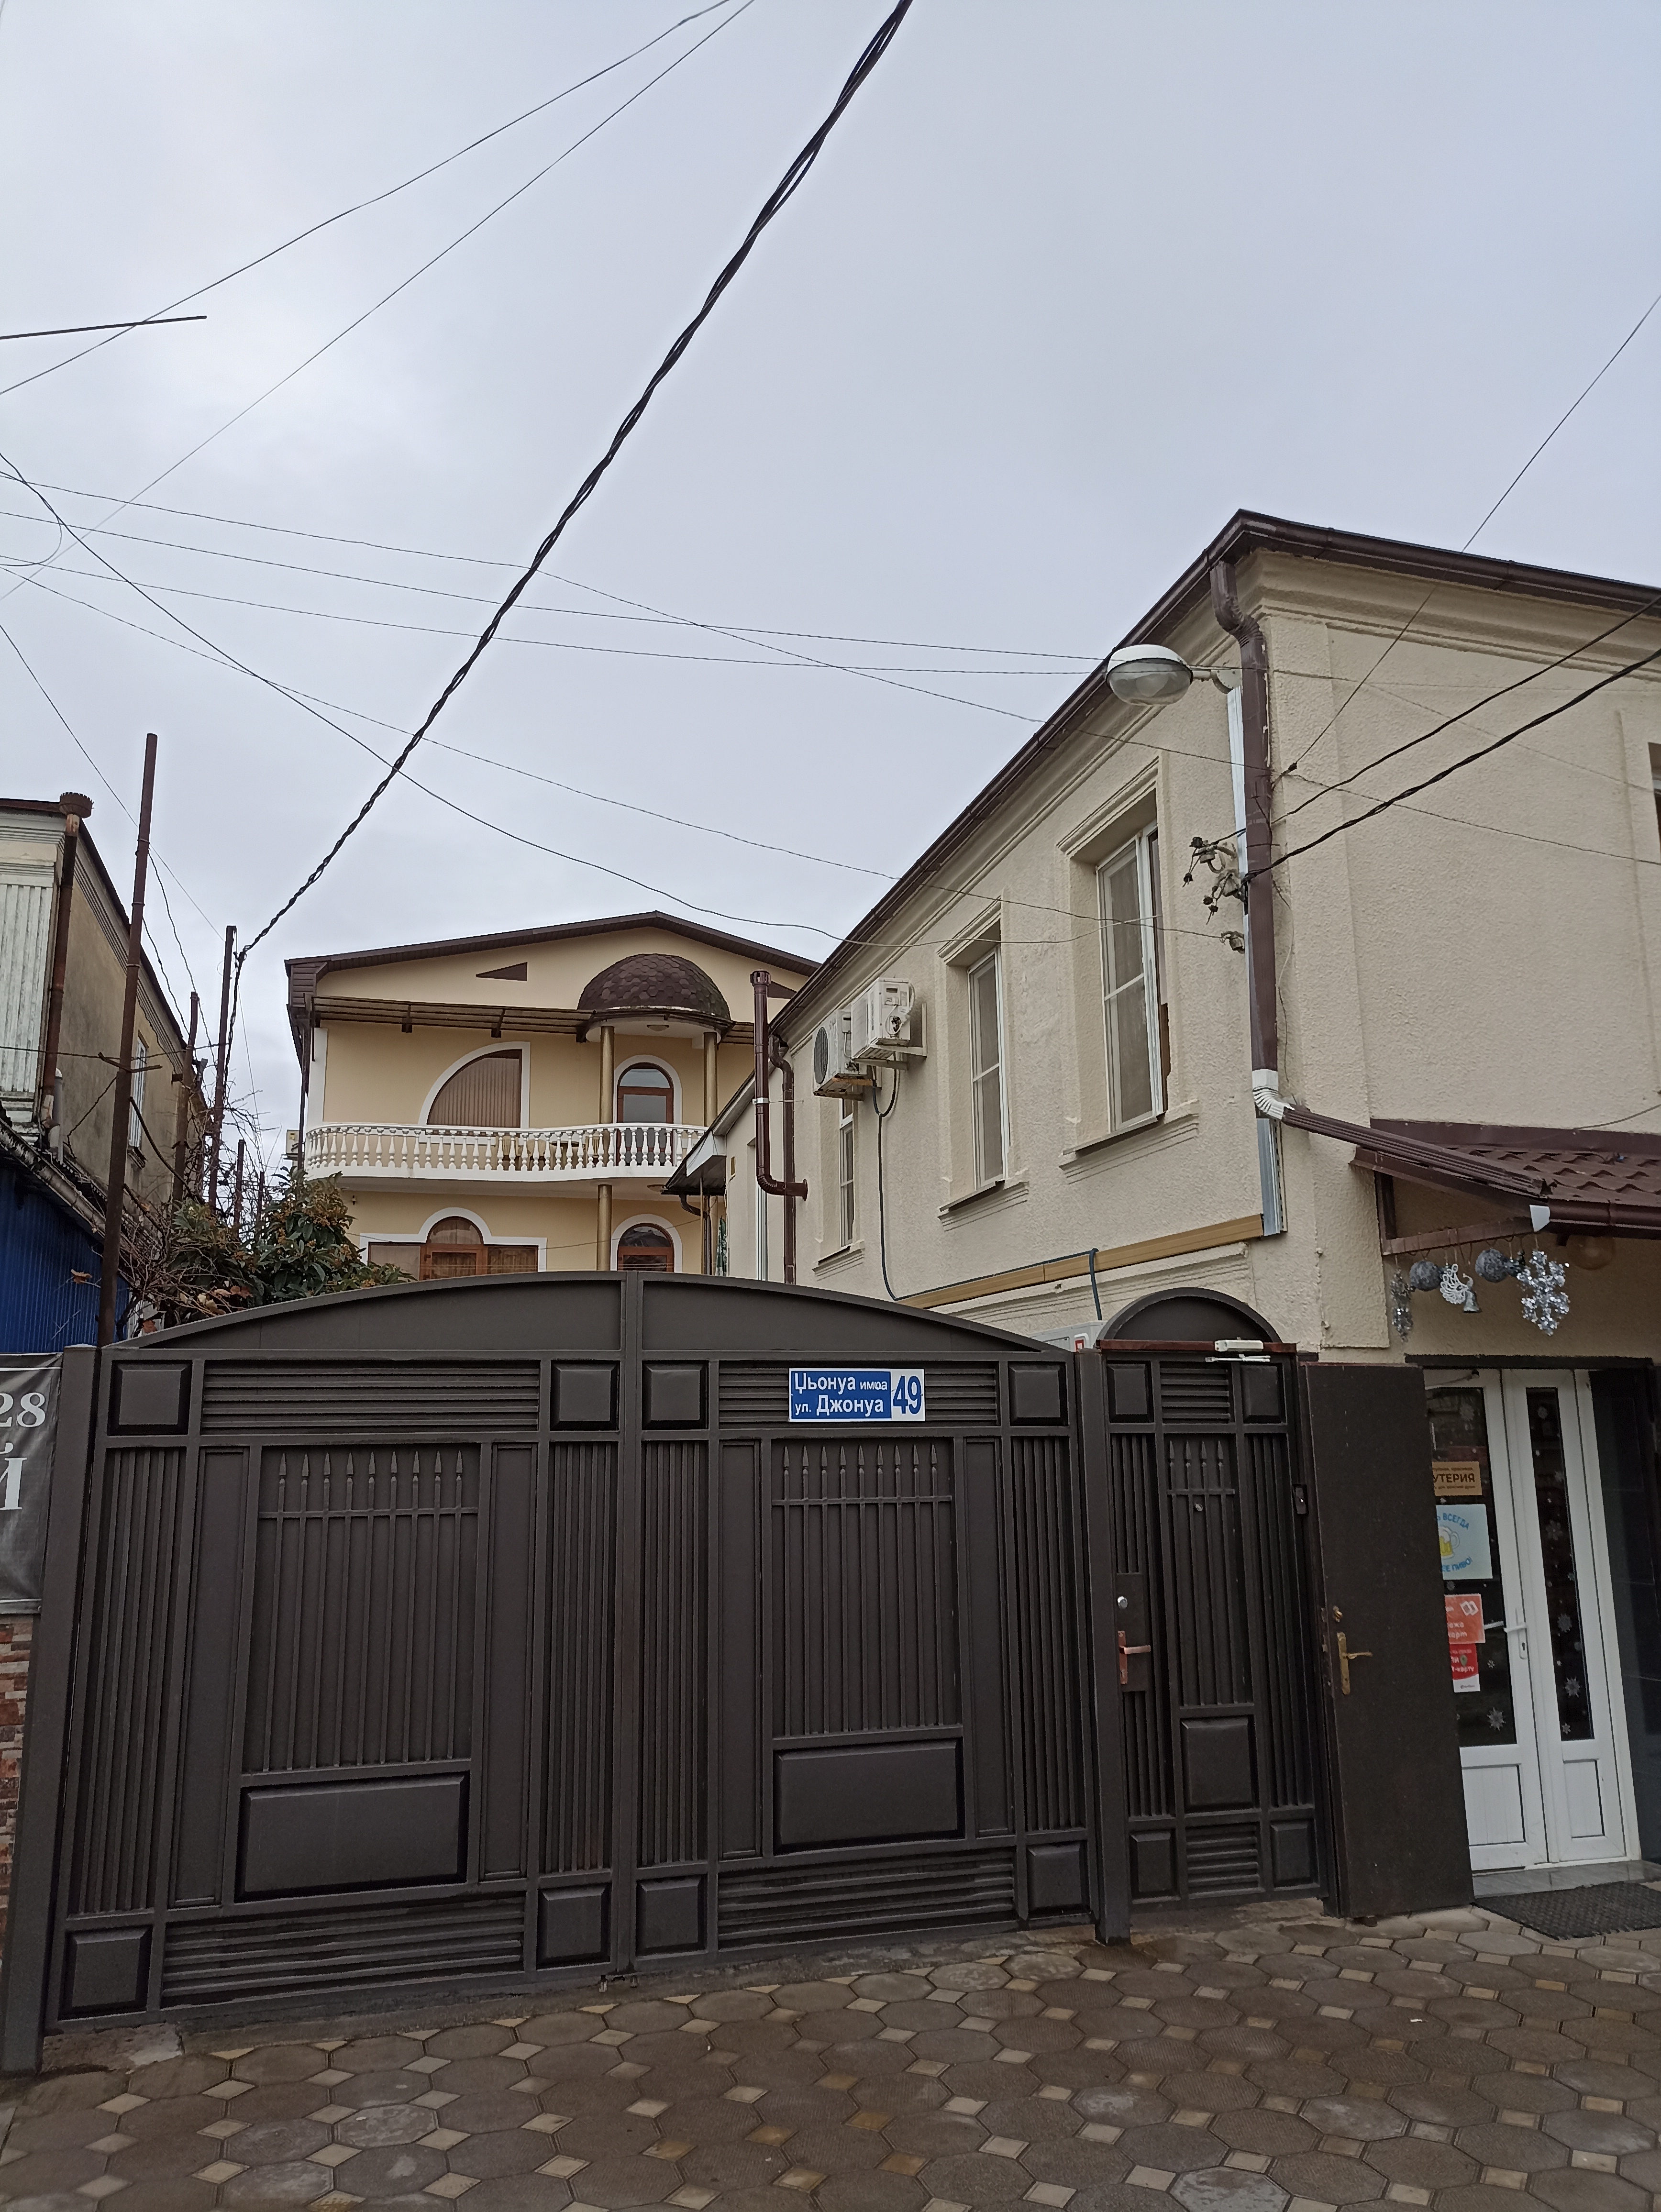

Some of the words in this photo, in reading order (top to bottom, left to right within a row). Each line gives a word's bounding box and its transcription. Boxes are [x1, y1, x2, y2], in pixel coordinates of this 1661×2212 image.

[795, 1404, 812, 1416] ул.
[816, 1394, 884, 1417] Джонуа
[893, 1375, 922, 1415] 49
[1442, 1513, 1469, 1530] ВСЕГДА
